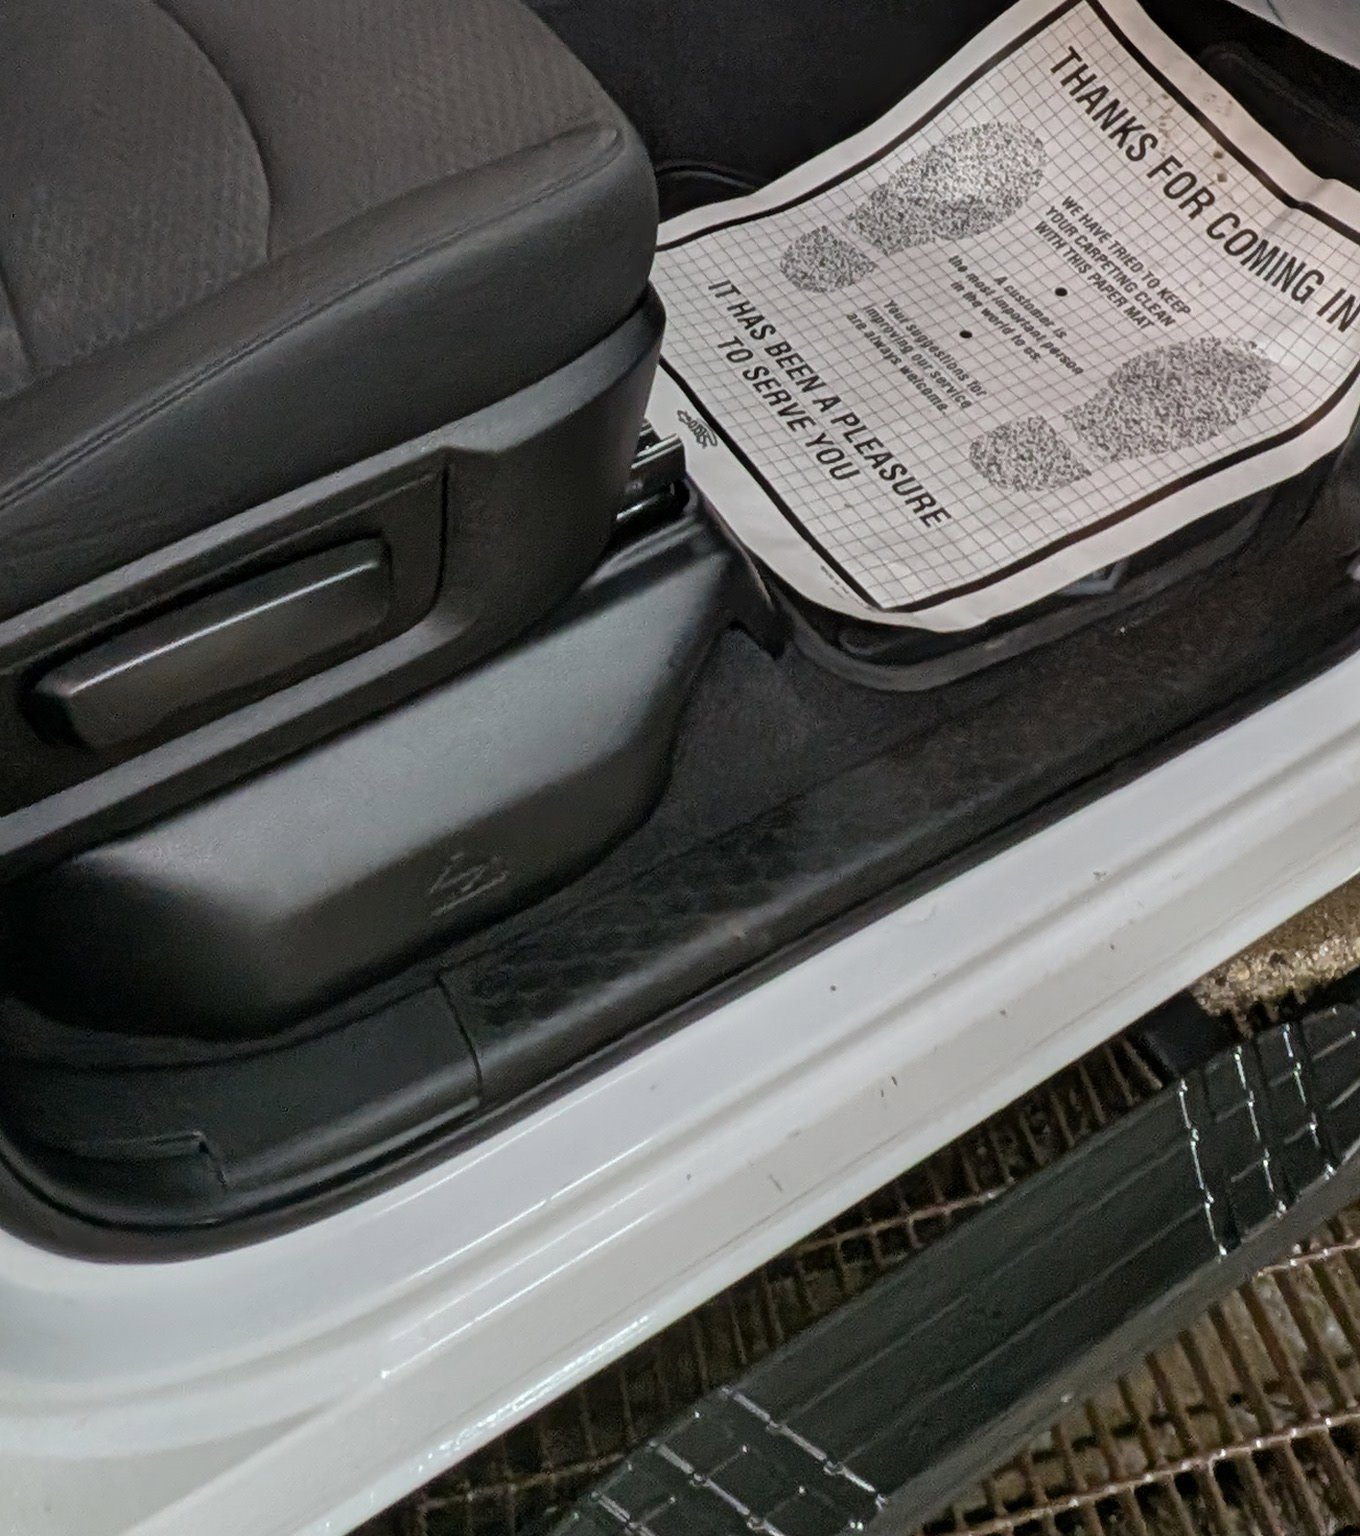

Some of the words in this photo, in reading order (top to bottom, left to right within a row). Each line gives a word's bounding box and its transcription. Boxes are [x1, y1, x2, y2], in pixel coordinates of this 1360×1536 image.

[1050, 45, 1159, 162] THANKS
[1146, 155, 1215, 220] FOR
[1206, 212, 1326, 305] COMING
[994, 276, 1008, 286] A
[1004, 285, 1055, 327] customer
[1053, 326, 1067, 339] is
[1034, 221, 1068, 250] WITH
[1062, 246, 1092, 274] THIS
[1087, 272, 1129, 308] PAPER
[1123, 306, 1155, 330] MAT
[1046, 206, 1079, 238] YOUR
[1074, 234, 1138, 294] CARPETING
[1134, 291, 1176, 327] CLEAN
[1062, 195, 1084, 217] WE
[1078, 214, 1113, 244] HAVE
[1108, 240, 1144, 274] TRIED
[1141, 271, 1161, 289] TO
[1157, 287, 1191, 314] KEEP
[846, 313, 867, 330] are
[864, 330, 902, 365] always
[863, 305, 914, 354] improving
[911, 353, 934, 372] our
[930, 370, 973, 409] service
[884, 299, 909, 324] Your
[905, 324, 970, 382] suggestions
[966, 380, 988, 397] for
[948, 255, 968, 273] the
[966, 273, 996, 296] most
[992, 295, 1047, 342] important
[1039, 341, 1084, 375] person
[950, 280, 965, 292] in
[962, 291, 983, 308] the
[981, 308, 1016, 335] world
[1011, 334, 1026, 347] to
[708, 279, 741, 299] IT
[726, 300, 776, 341] HAS
[764, 340, 827, 393] BEEN
[812, 395, 842, 413] A
[830, 411, 953, 528] PLEASURE
[717, 335, 754, 364] TO
[742, 365, 817, 432] SERVE
[805, 432, 861, 481] YOU
